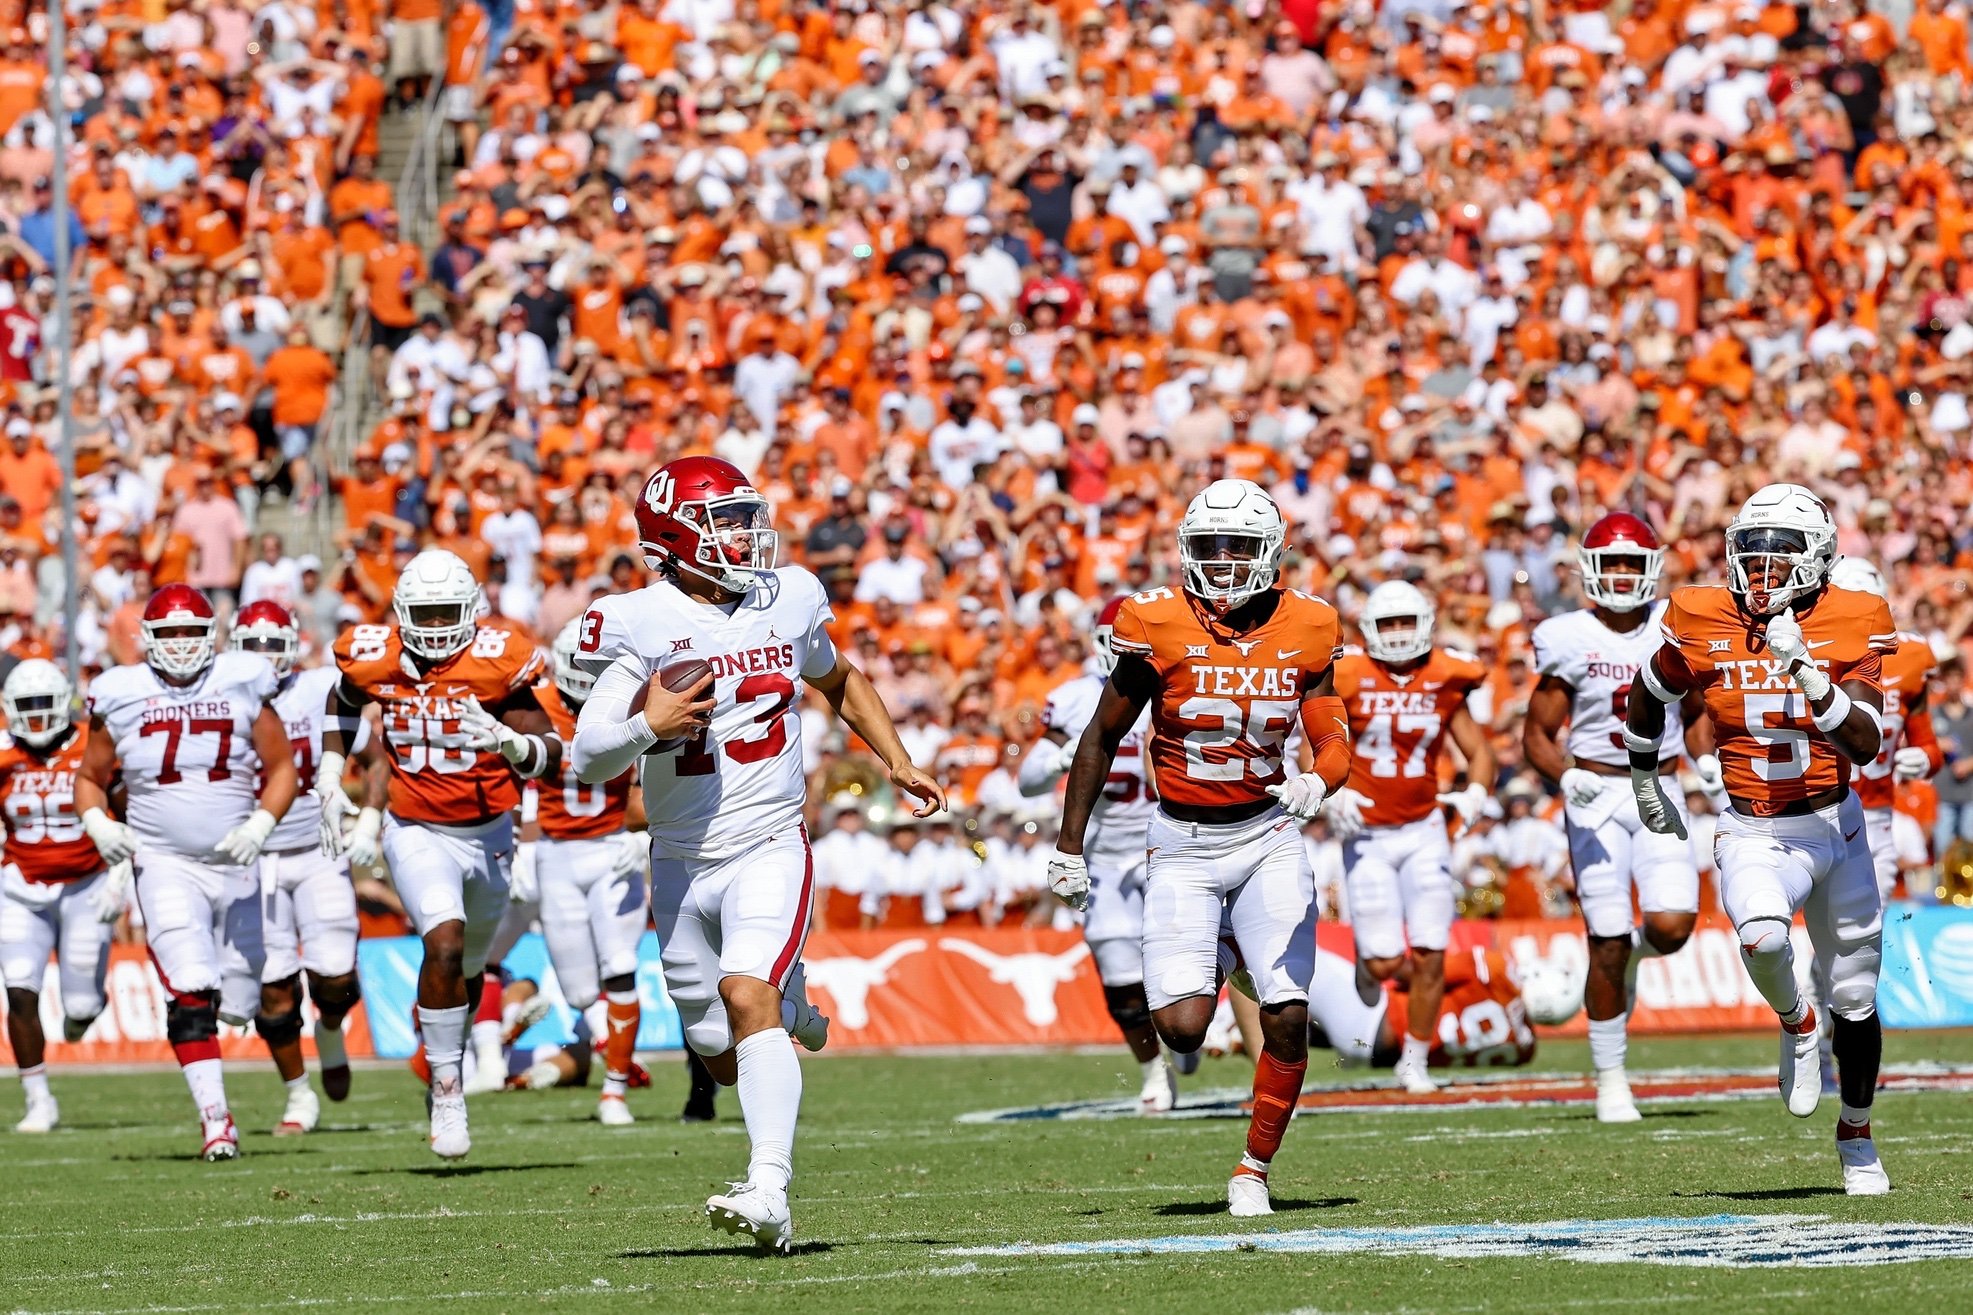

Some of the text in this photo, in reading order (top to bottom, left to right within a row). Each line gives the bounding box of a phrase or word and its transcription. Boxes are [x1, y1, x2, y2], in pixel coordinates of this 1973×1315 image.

[645, 470, 675, 514] OU
[670, 637, 695, 653] XII
[707, 644, 793, 679] ONERS
[1184, 644, 1210, 657] XII
[1708, 639, 1732, 651] XII
[1191, 665, 1299, 697] TEXAS
[1587, 663, 1641, 680] SOON
[142, 701, 231, 722] SOONERS
[1359, 691, 1437, 714] TEXAS
[675, 672, 795, 777] 13
[1178, 696, 1300, 782] 25
[1743, 693, 1811, 781] 5
[139, 718, 234, 785] 77
[1355, 713, 1441, 778] 47
